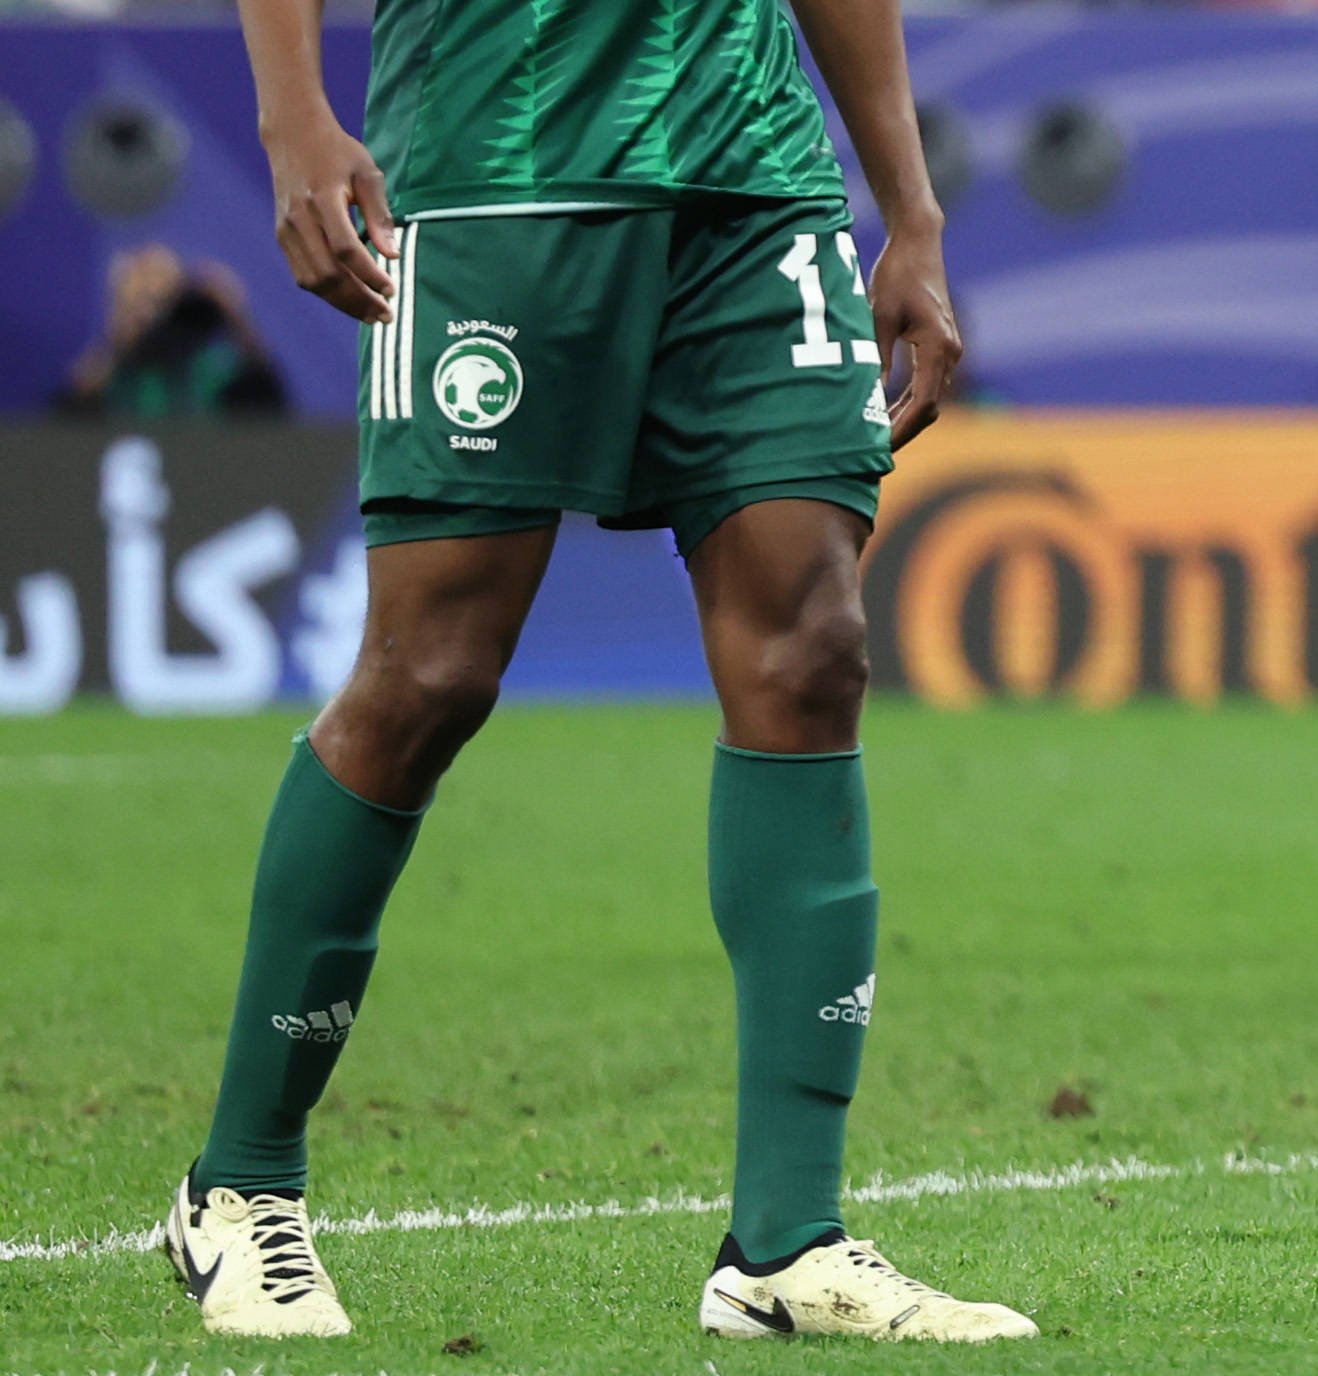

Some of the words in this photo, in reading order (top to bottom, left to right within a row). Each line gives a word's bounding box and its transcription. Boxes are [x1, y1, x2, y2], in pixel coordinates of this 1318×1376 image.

[479, 393, 506, 404] SAFF
[449, 435, 498, 452] SAUDI
[819, 1004, 872, 1027] adid
[271, 1013, 349, 1043] adida
